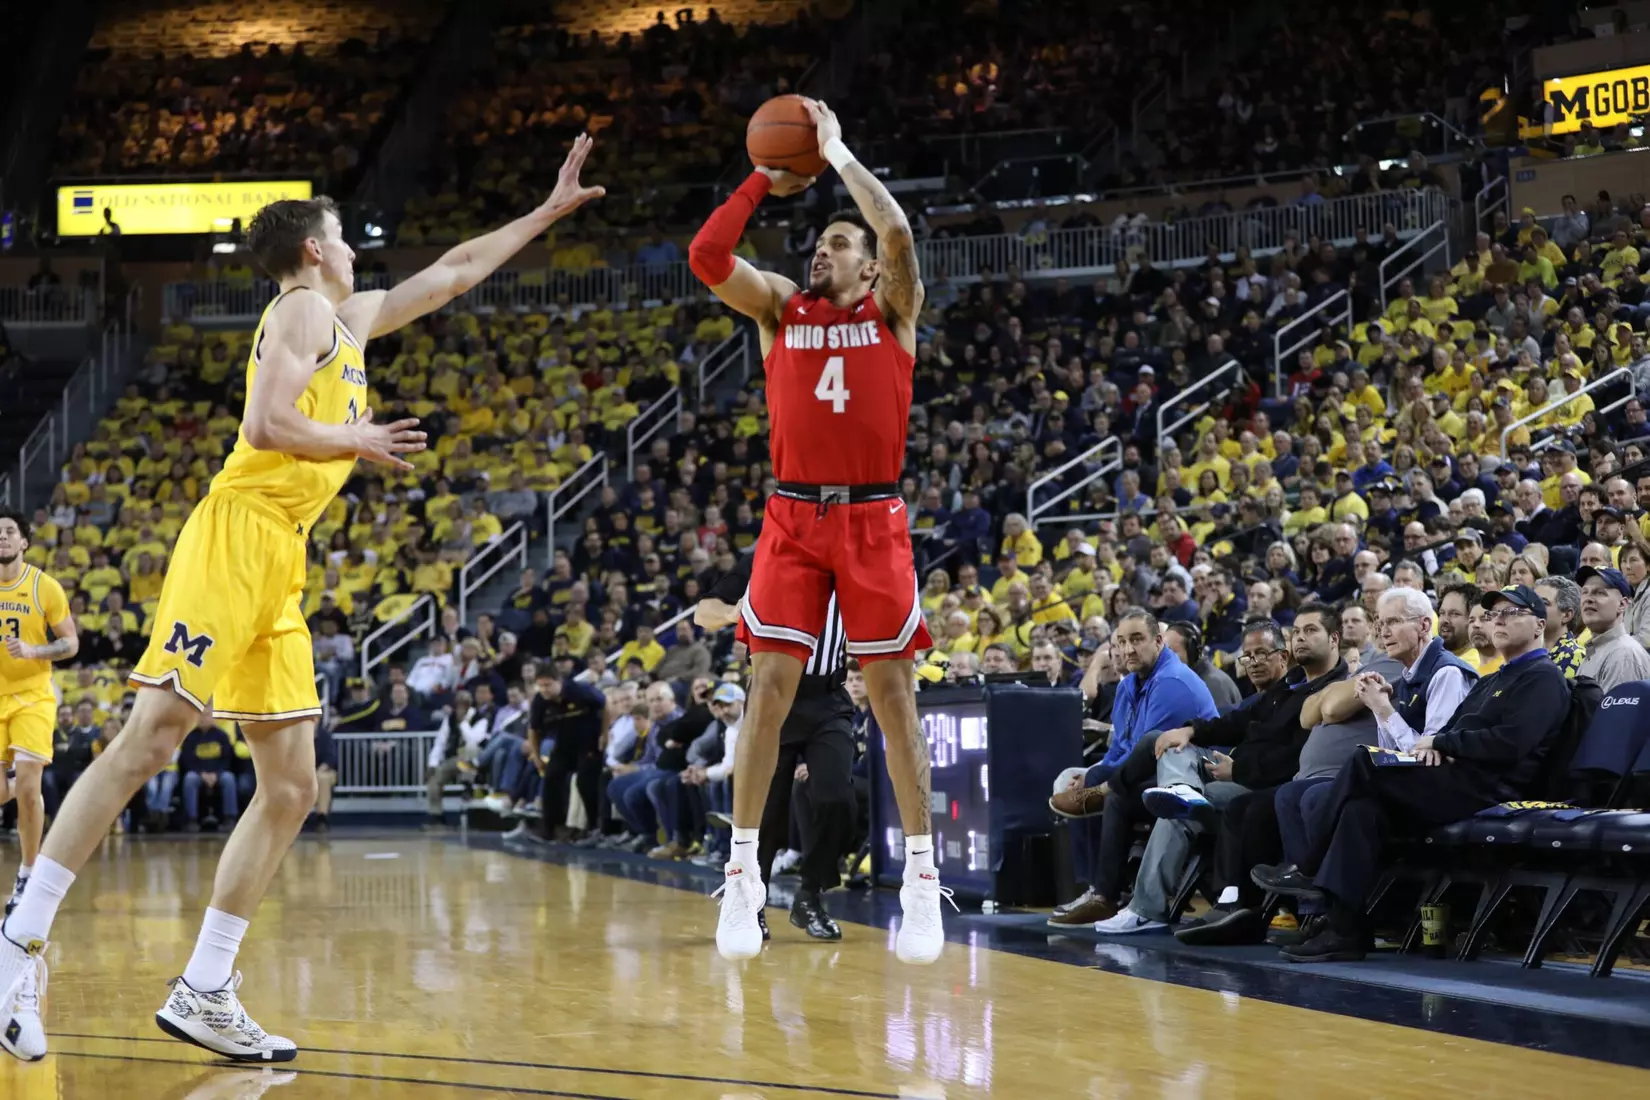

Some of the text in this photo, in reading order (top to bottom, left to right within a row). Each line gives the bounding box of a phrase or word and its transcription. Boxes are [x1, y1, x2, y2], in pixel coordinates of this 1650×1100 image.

[785, 320, 880, 349] OHIO STATE
[814, 356, 850, 413] 4
[164, 621, 213, 668] M
[1612, 697, 1640, 706] LEXUS
